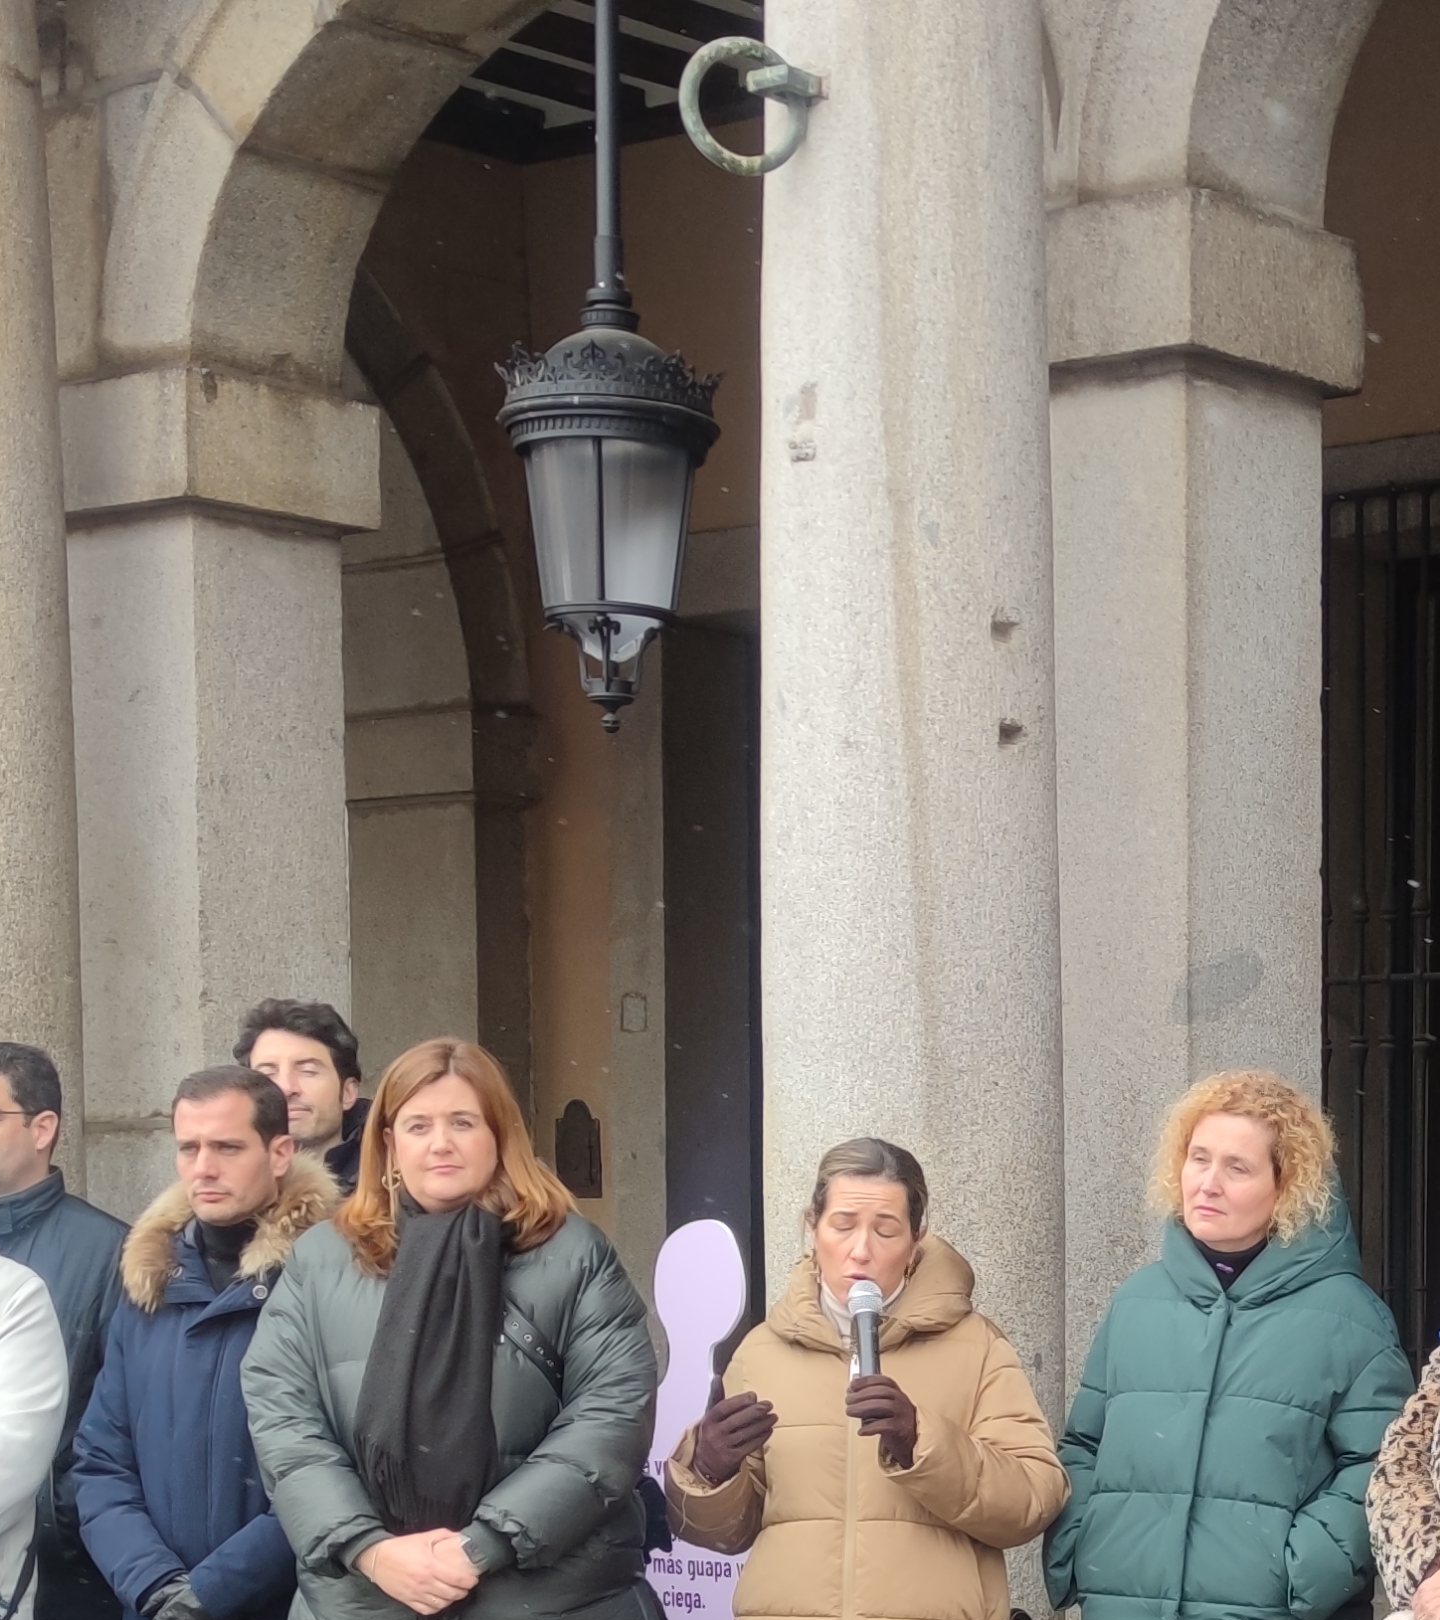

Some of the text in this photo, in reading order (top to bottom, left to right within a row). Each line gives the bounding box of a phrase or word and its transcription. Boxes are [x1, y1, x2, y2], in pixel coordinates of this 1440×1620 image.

[653, 1552, 683, 1575] más
[687, 1559, 732, 1583] guapa
[662, 1585, 706, 1613] ciega.
